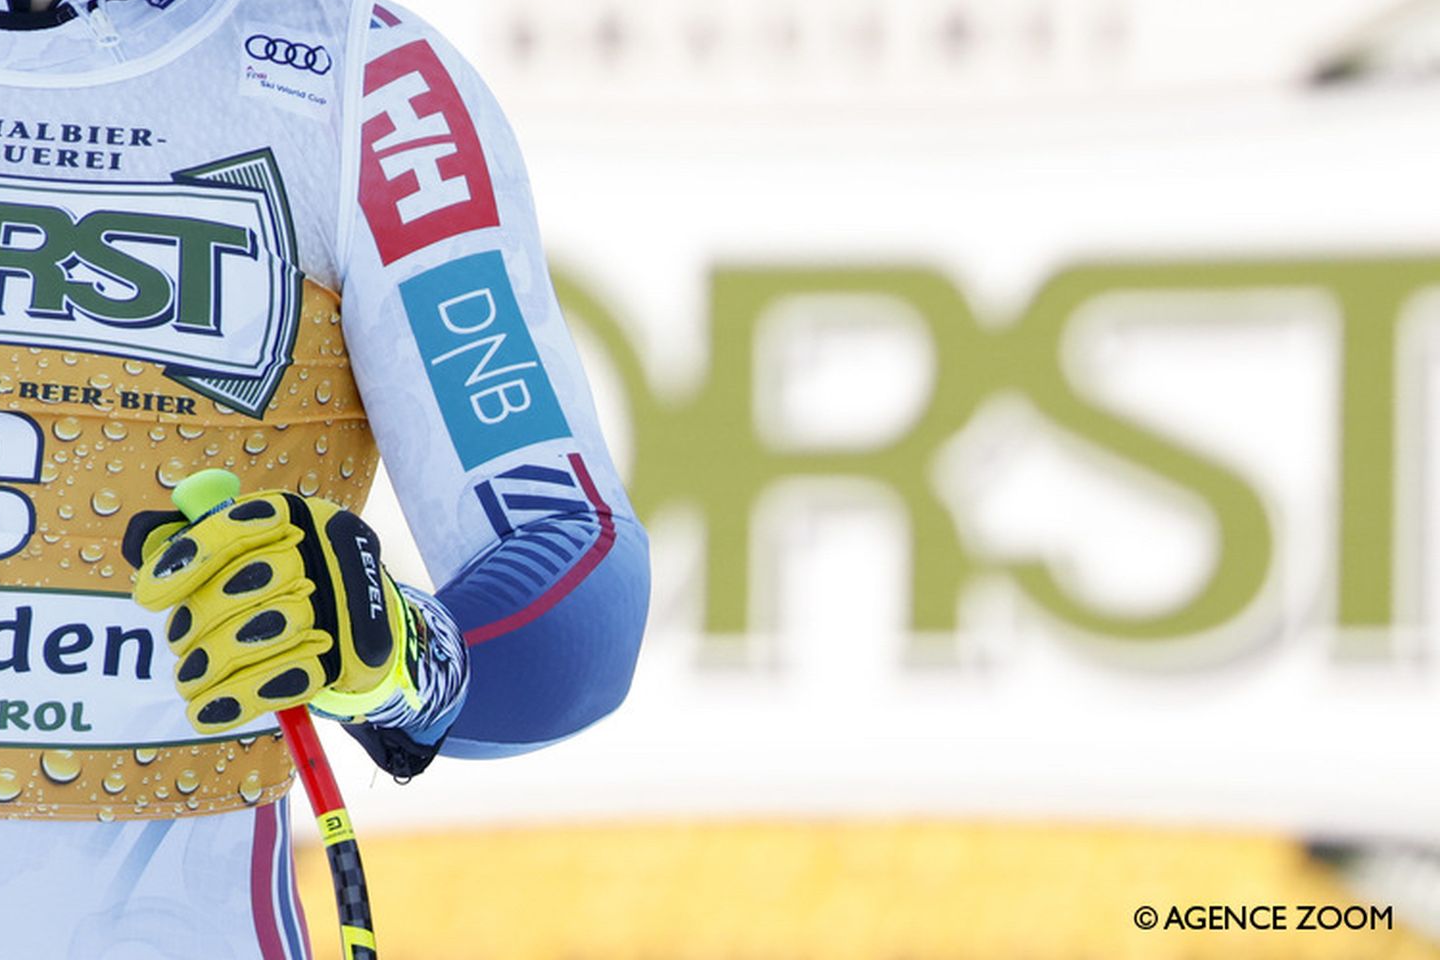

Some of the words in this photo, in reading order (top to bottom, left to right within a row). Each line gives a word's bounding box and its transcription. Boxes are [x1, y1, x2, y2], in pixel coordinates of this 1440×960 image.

[361, 70, 472, 225] HH
[431, 287, 538, 426] DNB
[545, 257, 1440, 642] RST
[355, 536, 384, 620] LEVEL
